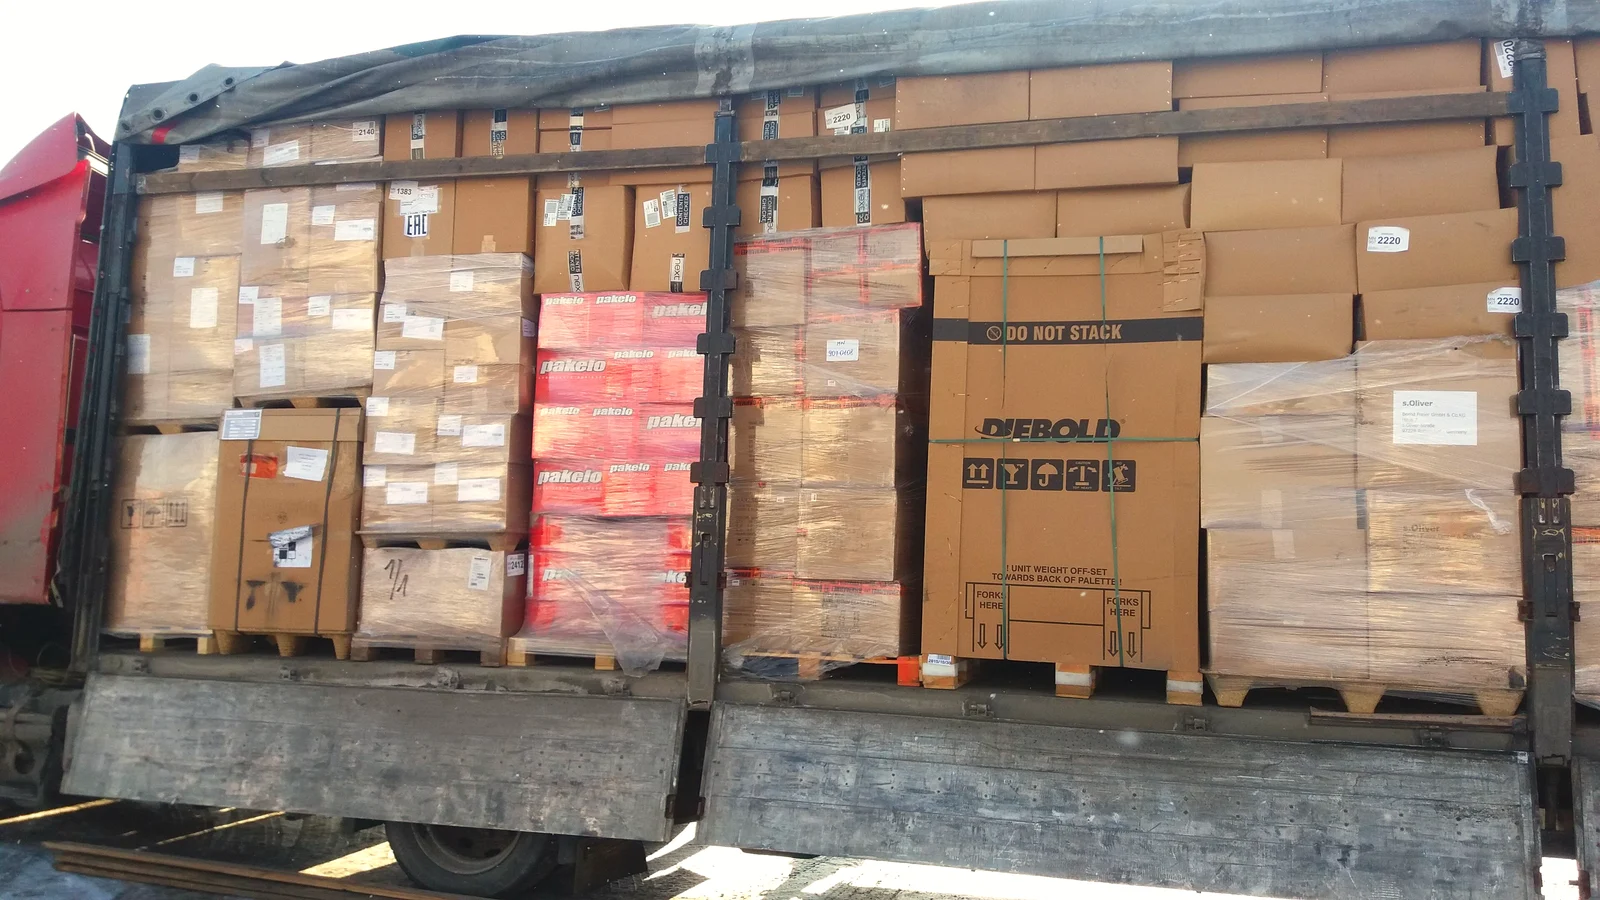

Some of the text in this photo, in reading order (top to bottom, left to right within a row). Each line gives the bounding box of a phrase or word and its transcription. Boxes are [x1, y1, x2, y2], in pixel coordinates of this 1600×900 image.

[832, 113, 851, 123] 2220
[358, 128, 375, 136] 2140
[1377, 236, 1401, 245] 2220
[573, 275, 581, 292] nex
[545, 296, 584, 305] pakelo
[596, 294, 636, 304] pakelo
[1497, 297, 1520, 305] 2220
[652, 302, 707, 318] pakel
[1006, 324, 1122, 341] DO NOT STACK
[614, 349, 654, 359] pakelo
[668, 349, 704, 358] pake
[540, 358, 607, 374] pakelo
[1402, 399, 1433, 407] s.Oliver
[540, 406, 580, 416] pakelo
[593, 407, 633, 417] pakelo
[647, 413, 702, 429] pakel
[976, 418, 1121, 443] DIEBOLD
[609, 462, 650, 473] pakelo
[664, 462, 690, 471] pake
[537, 469, 603, 485] pakelo
[511, 560, 524, 569] 2412
[1011, 565, 1032, 573] UNIT
[1033, 565, 1068, 574] WEIGHT
[1070, 567, 1107, 576] OFF-SET
[992, 573, 1034, 581] TOWARDS
[1037, 575, 1061, 583] BACK
[1078, 576, 1116, 585] PALETTE
[976, 590, 1006, 599] FORKS
[979, 601, 1004, 610] HERE
[1106, 597, 1139, 607] FORKS
[1110, 608, 1136, 617] HERE
